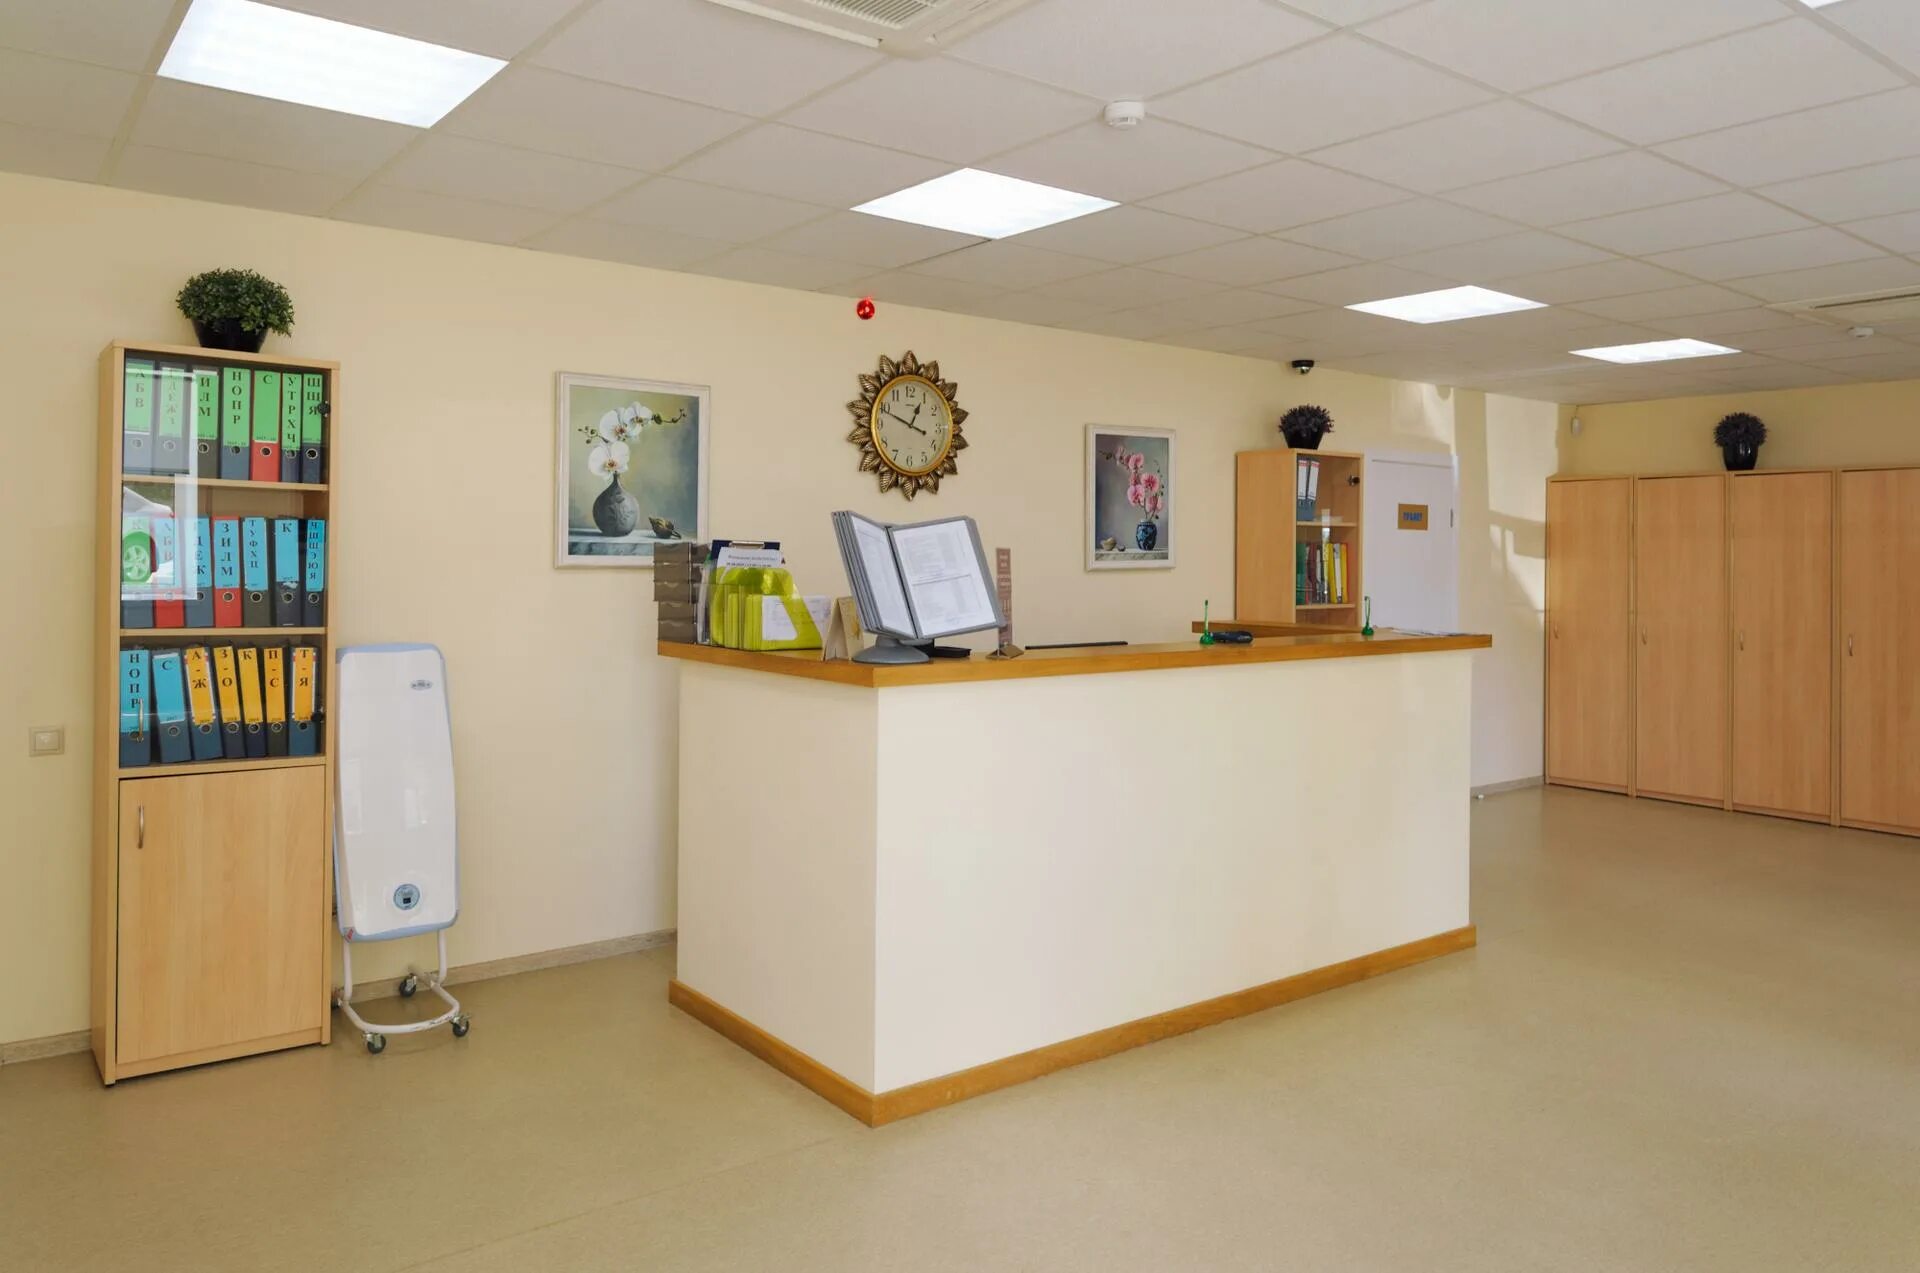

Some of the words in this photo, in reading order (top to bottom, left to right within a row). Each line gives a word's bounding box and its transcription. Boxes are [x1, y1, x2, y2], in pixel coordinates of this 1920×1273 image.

[892, 390, 900, 402] 11
[906, 386, 915, 398] 12
[922, 392, 927, 404] 1
[931, 407, 937, 416] 2
[930, 440, 937, 452] 4
[892, 449, 898, 461] 7
[921, 451, 927, 463] 5
[906, 455, 913, 468] 6
